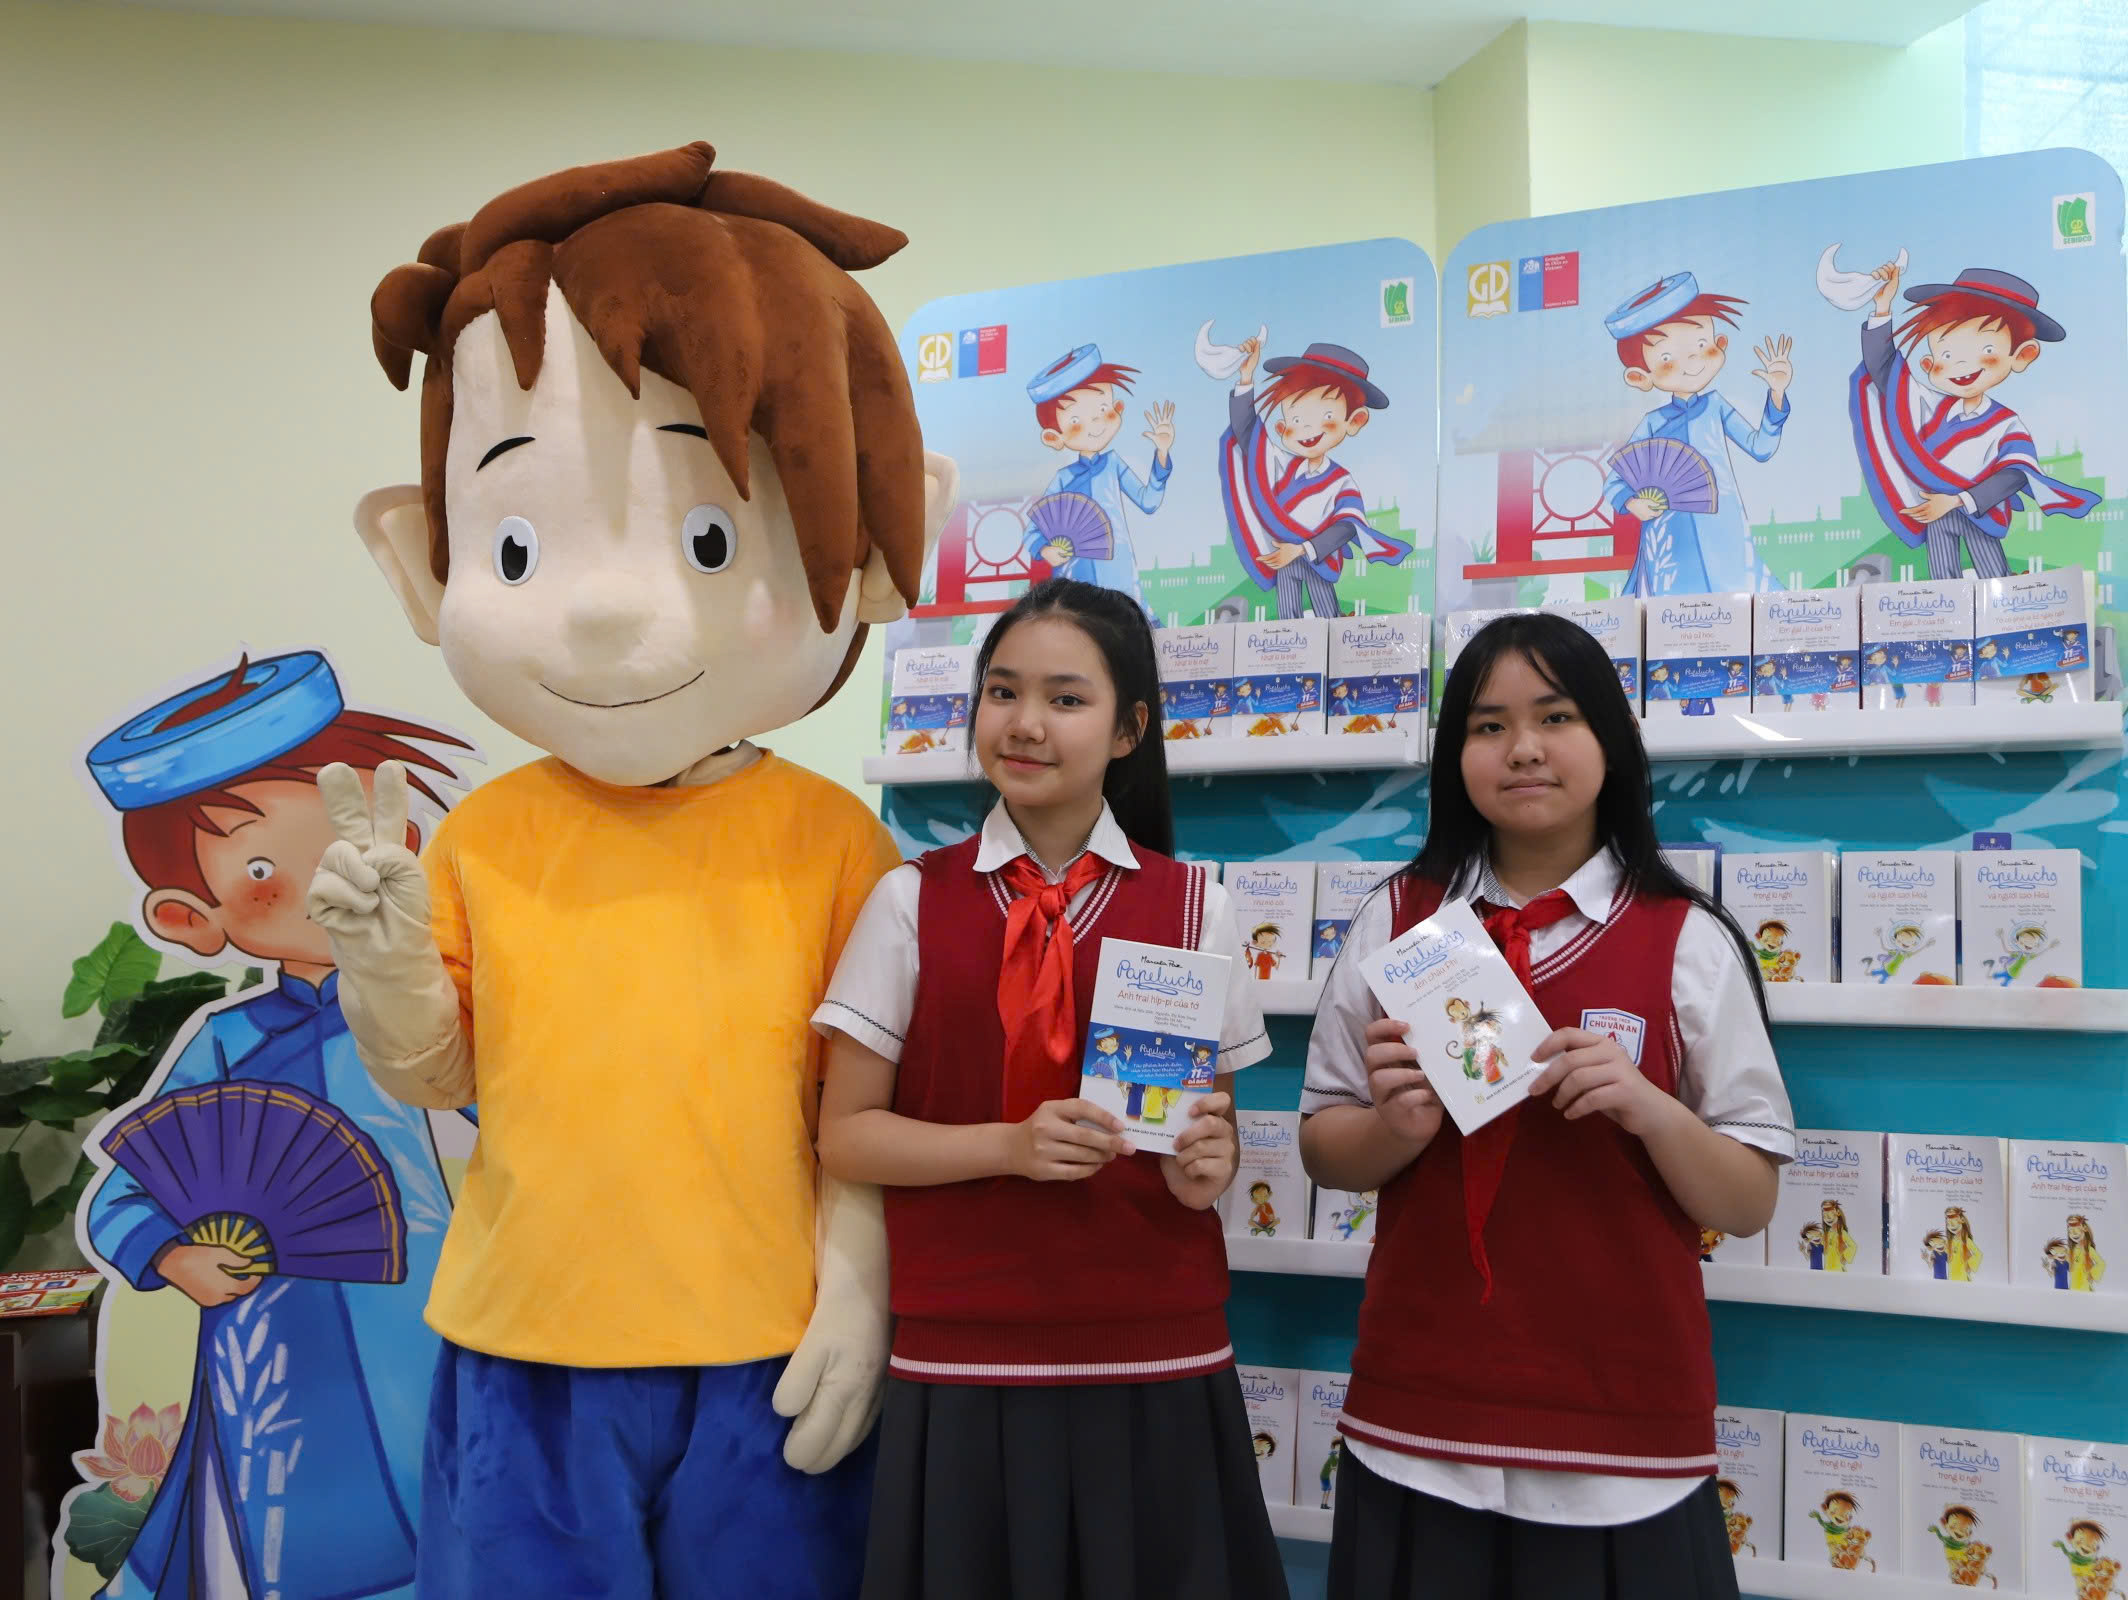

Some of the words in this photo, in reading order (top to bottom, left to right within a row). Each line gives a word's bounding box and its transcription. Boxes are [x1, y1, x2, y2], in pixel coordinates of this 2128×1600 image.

[1470, 264, 1509, 301] GD
[919, 335, 952, 368] GD
[1769, 601, 1842, 623] Papelucho
[1879, 593, 1956, 617] Papelucho
[1662, 607, 1732, 629] Papelucho
[1163, 637, 1219, 658] Papelucho
[1248, 632, 1308, 653] Papelucho
[1342, 627, 1404, 648] Papelucho
[1237, 876, 1297, 896] Papelucho
[1737, 866, 1808, 889] Papelucho
[1858, 865, 1935, 889] Papelucho
[1977, 866, 2058, 889] Papelucho
[1384, 930, 1465, 984] Papelucho
[1116, 959, 1203, 996] Papelucho
[1414, 979, 1427, 992] đến
[1428, 969, 1446, 983] châu
[1118, 989, 1135, 1001] Anh
[1136, 992, 1150, 1002] trai
[1173, 999, 1189, 1009] của
[1190, 1001, 1200, 1010] tớ
[1590, 1020, 1607, 1028] CHU
[1626, 1025, 1637, 1033] AN
[1139, 1043, 1177, 1060] Papelucho
[1191, 1068, 1201, 1078] 11
[1795, 1145, 1860, 1168] apelucho
[1906, 1149, 1983, 1174] Papelucho
[2027, 1155, 2108, 1181] Papelucho
[1788, 1168, 1802, 1177] Anh
[1803, 1169, 1814, 1177] trai
[1911, 1175, 1925, 1183] Anh
[1313, 1384, 1346, 1408] Papel
[1802, 1429, 1880, 1459] Papelucho
[1920, 1442, 2000, 1472] Papelucho
